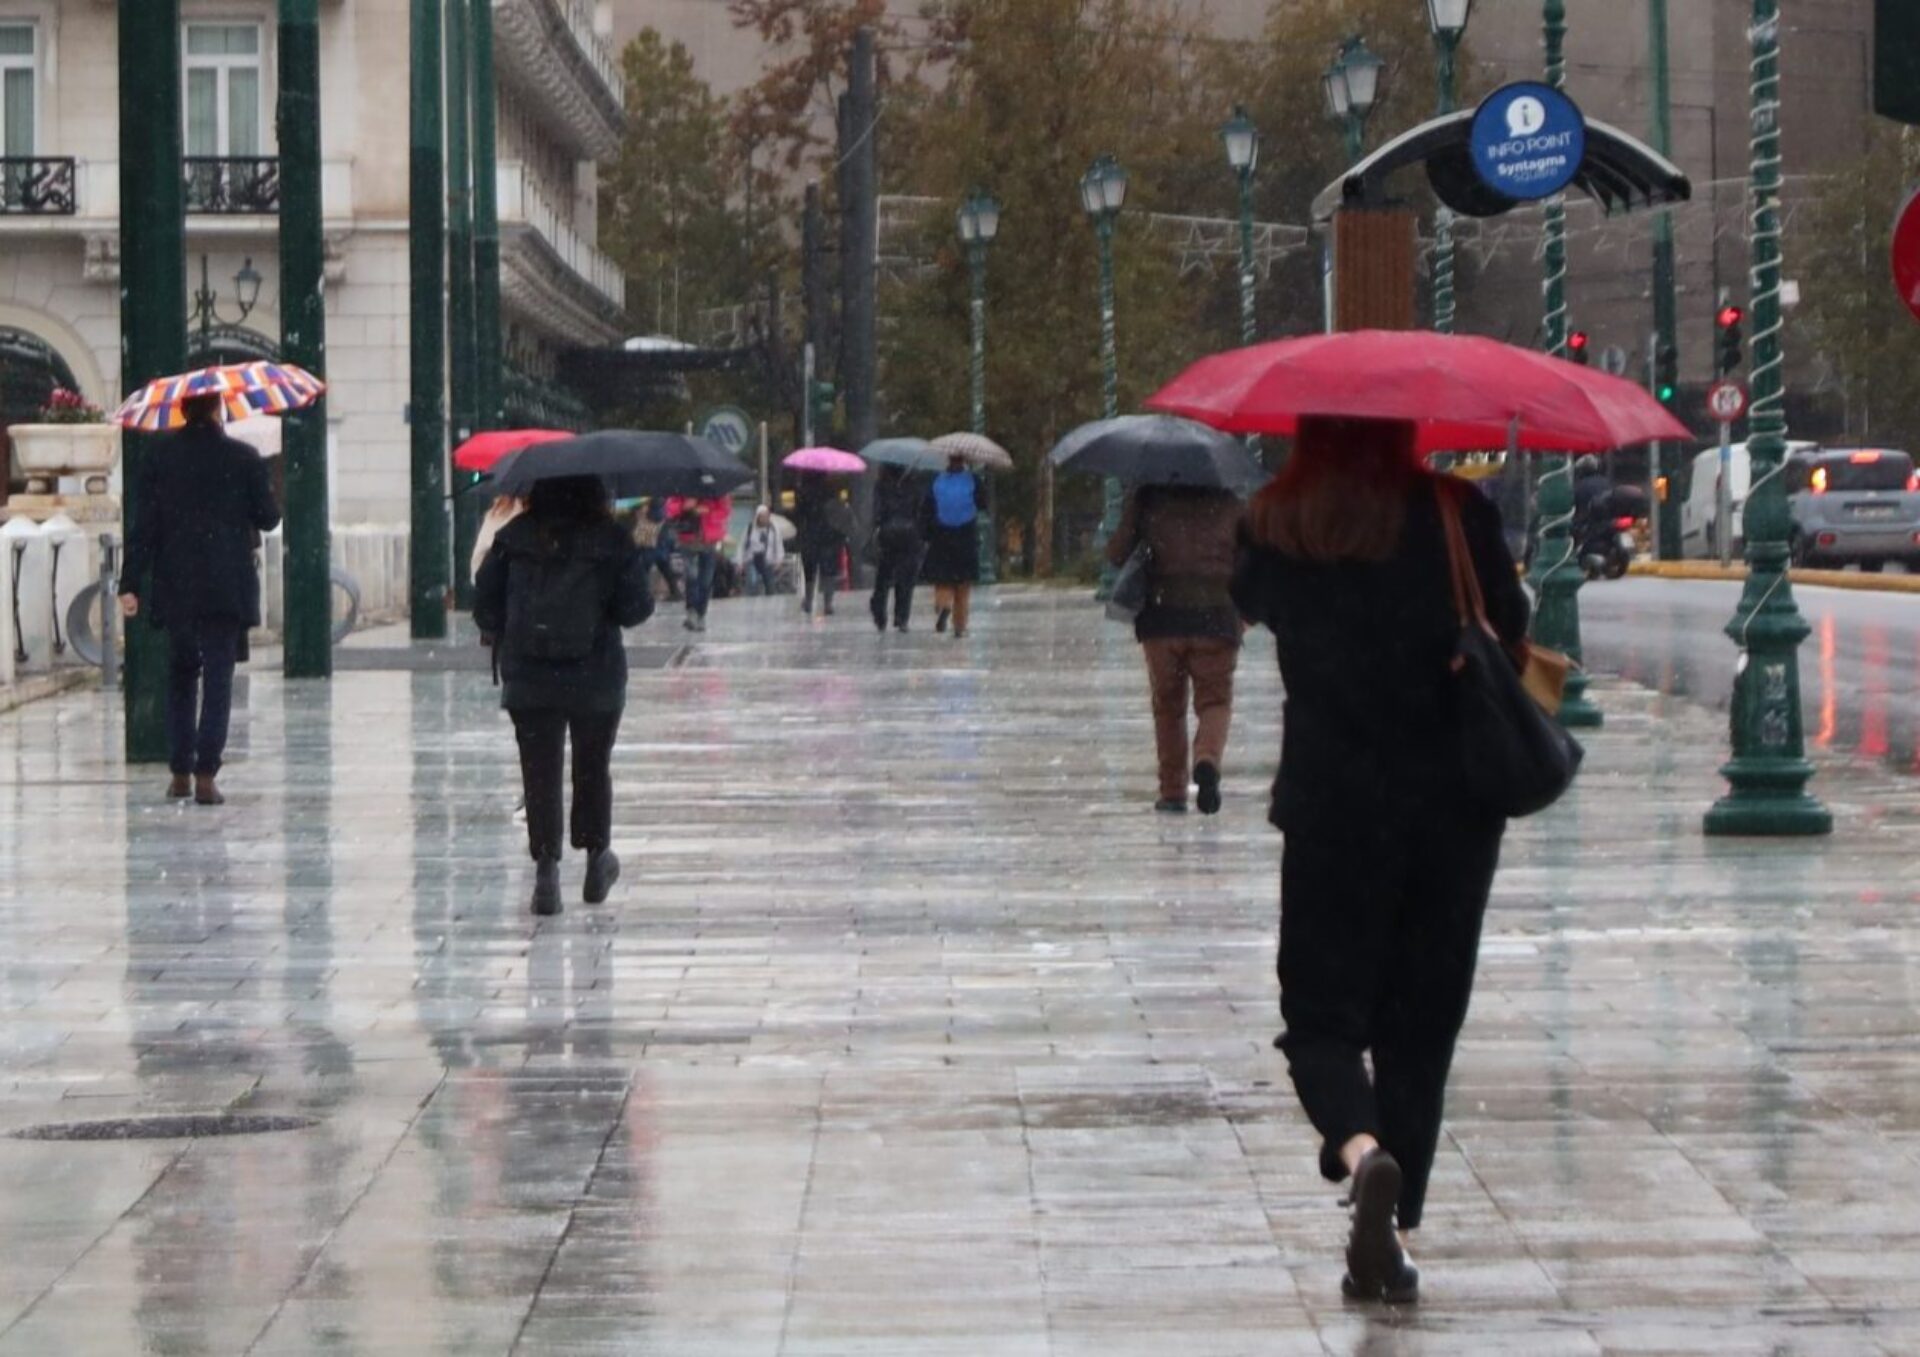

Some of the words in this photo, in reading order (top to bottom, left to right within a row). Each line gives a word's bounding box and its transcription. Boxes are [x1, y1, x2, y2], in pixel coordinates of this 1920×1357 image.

[1488, 140, 1524, 158] INFO
[1526, 132, 1571, 151] POINT
[1498, 155, 1566, 176] Syntagma
